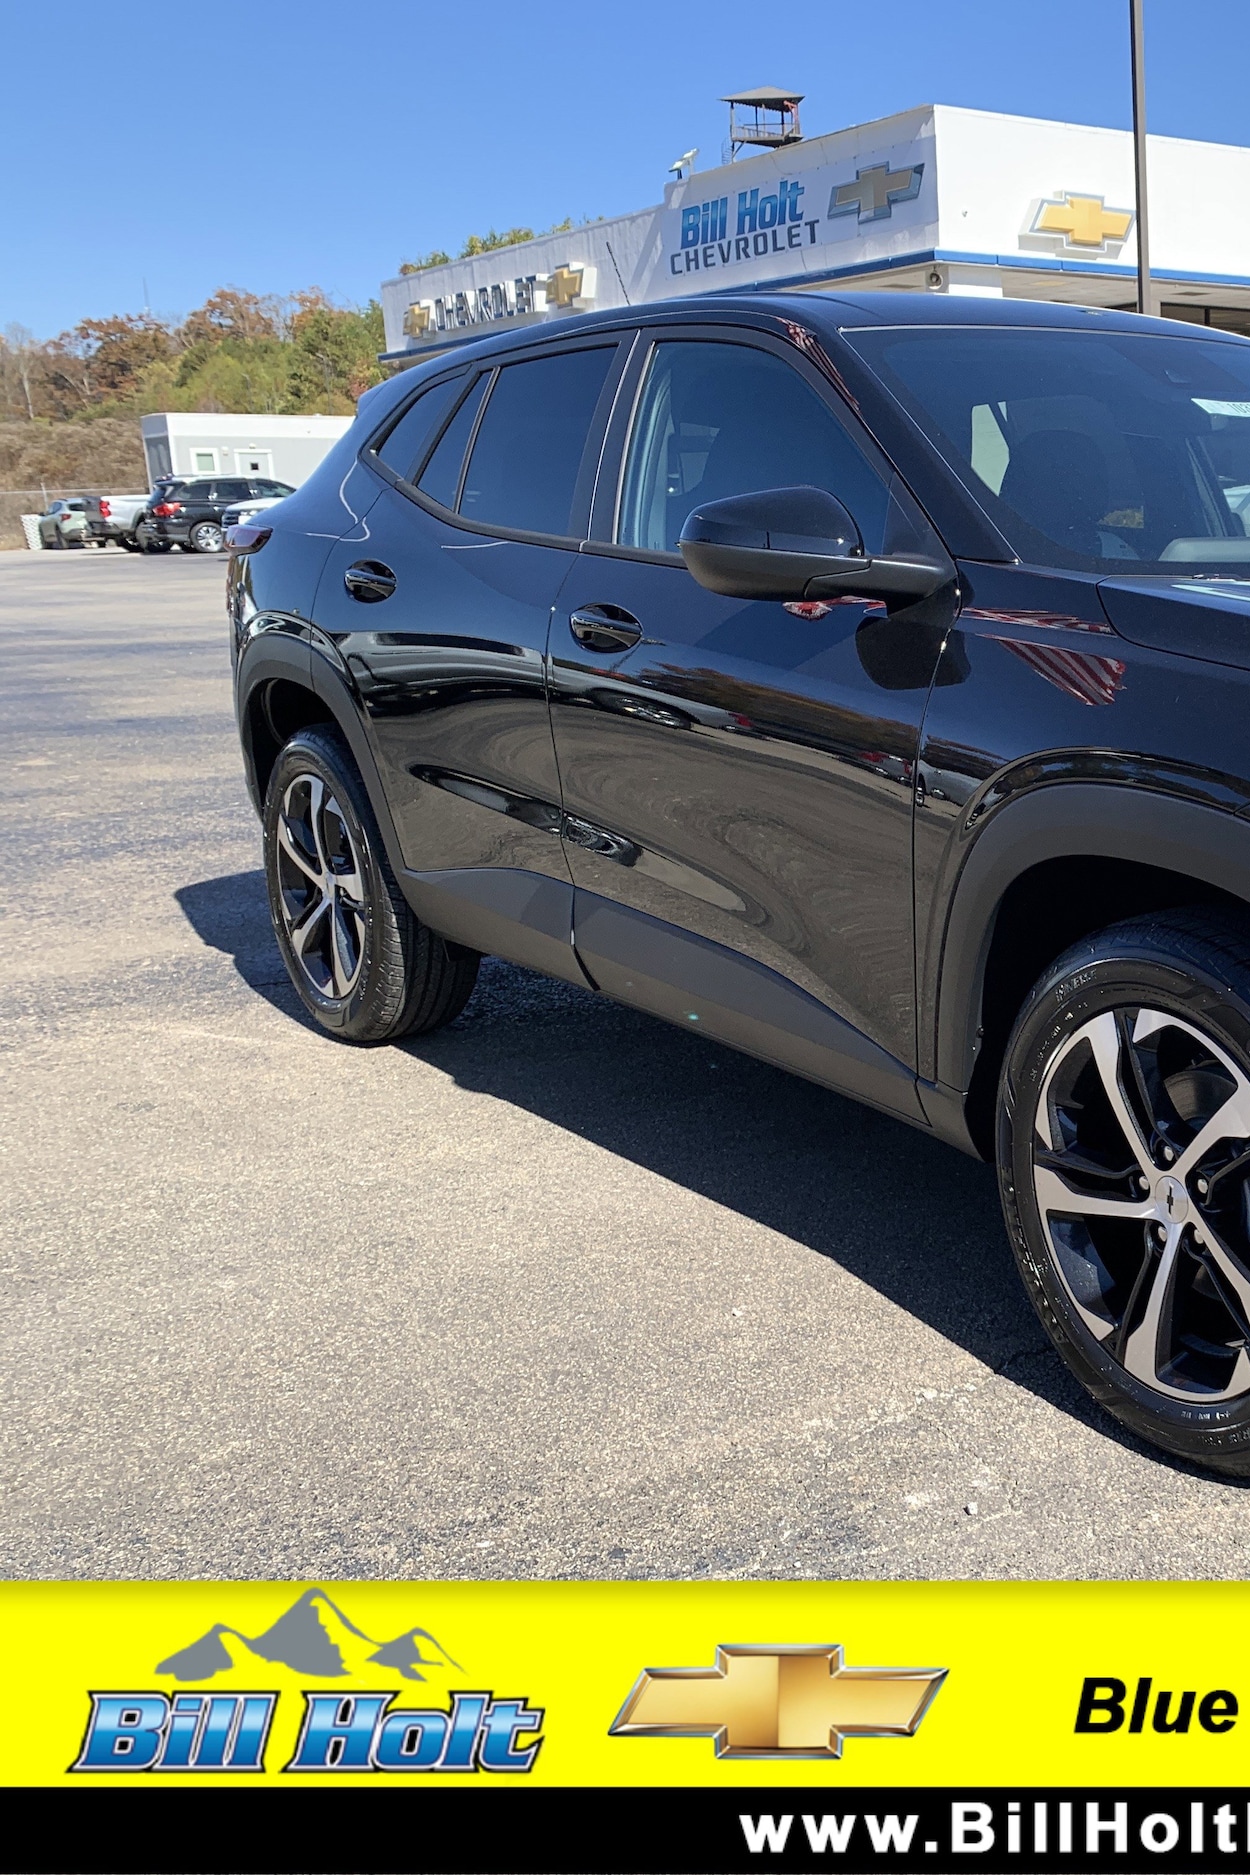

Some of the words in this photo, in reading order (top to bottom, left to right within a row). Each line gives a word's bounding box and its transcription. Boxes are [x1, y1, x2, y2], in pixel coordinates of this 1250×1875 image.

[681, 197, 728, 250] Bill
[736, 180, 805, 236] Holt
[670, 219, 820, 275] CHEVROLET
[434, 274, 538, 331] CHEVROLET
